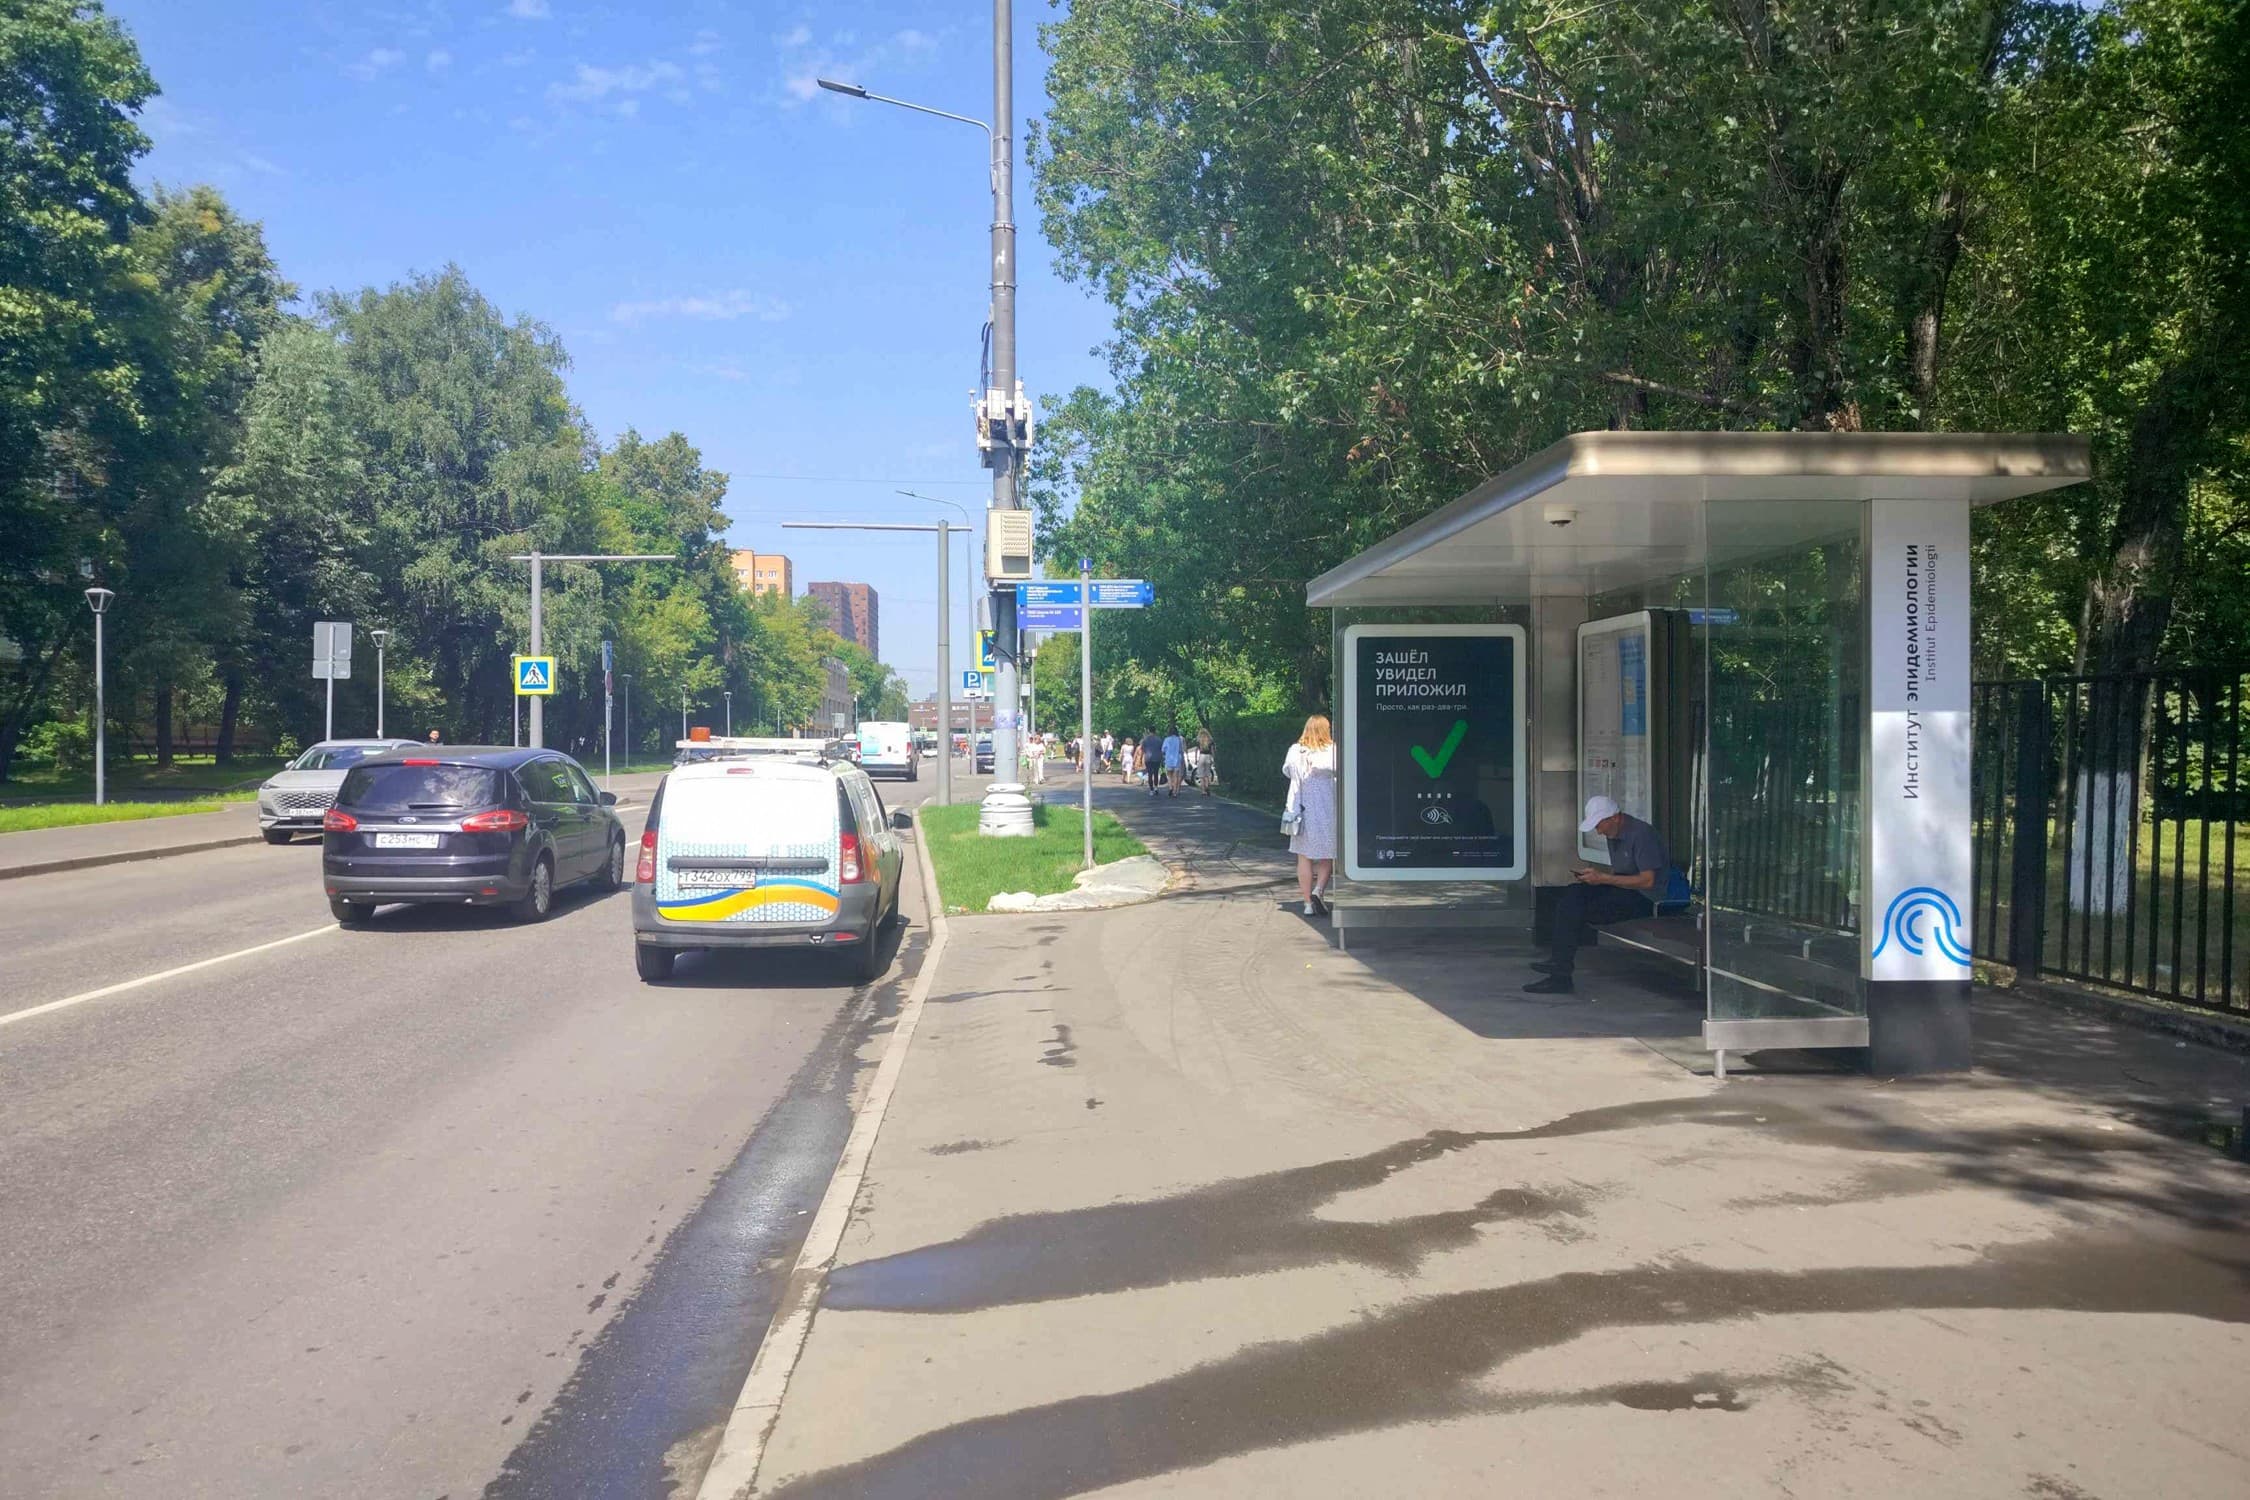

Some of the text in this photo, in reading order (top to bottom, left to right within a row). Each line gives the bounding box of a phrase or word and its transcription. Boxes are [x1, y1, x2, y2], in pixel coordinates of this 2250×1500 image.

[1924, 544, 1938, 632] Epidemiologii
[1376, 648, 1428, 664] ЗАШЁЛ
[1376, 668, 1437, 682] УВИДЕЛ
[1903, 544, 1922, 799] Институт эпидемиологии
[1376, 684, 1467, 697] ПРИЛОЖИЛ
[1376, 703, 1406, 712] Просто,
